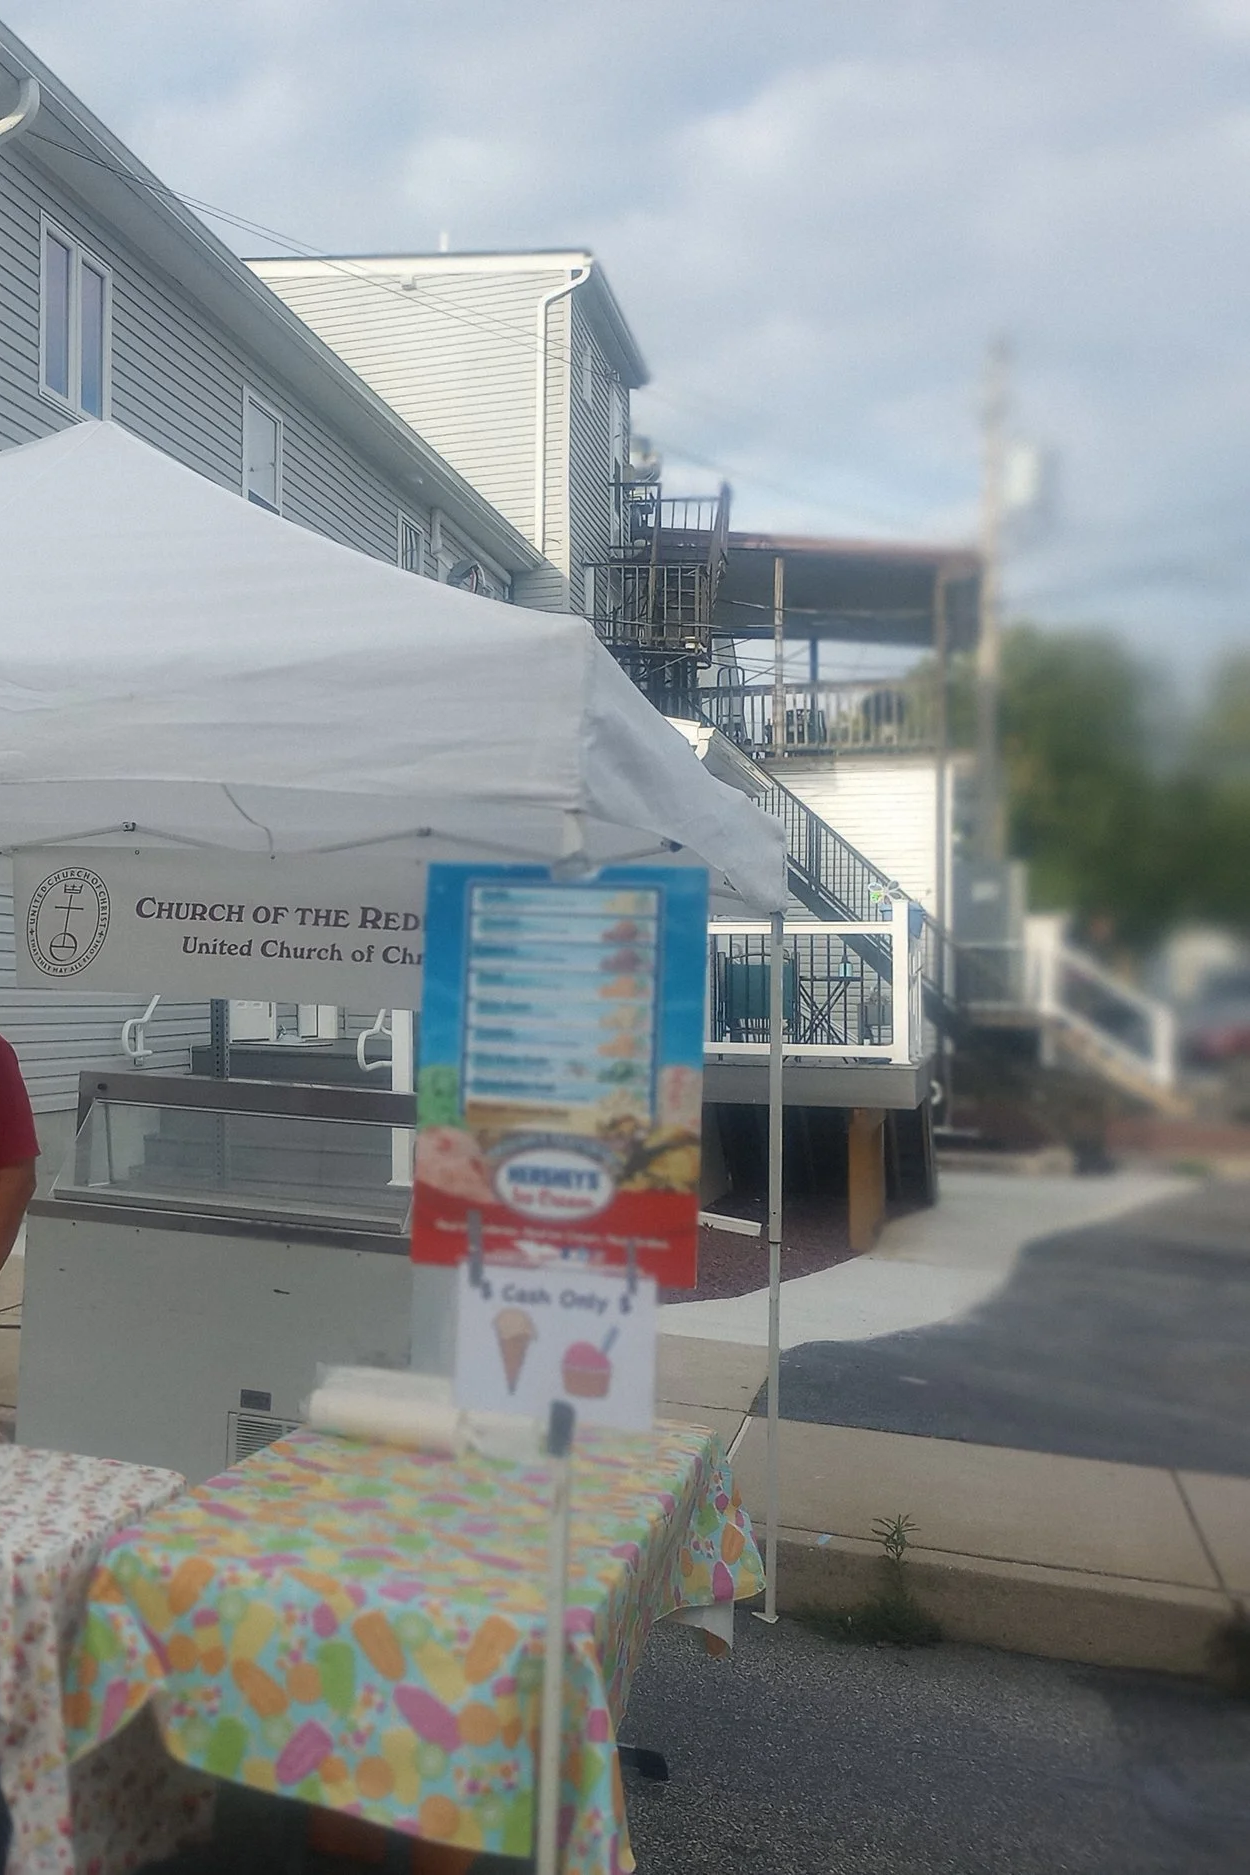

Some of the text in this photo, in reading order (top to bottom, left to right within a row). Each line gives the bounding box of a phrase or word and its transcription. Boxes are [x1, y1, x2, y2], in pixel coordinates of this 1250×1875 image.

[29, 886, 47, 925] UNITED
[47, 870, 91, 886] CHURCH
[135, 897, 245, 923] CHURCH
[252, 905, 288, 925] OF
[294, 907, 350, 929] THE
[182, 935, 252, 957] United
[260, 939, 343, 961] Church
[350, 945, 375, 963] of
[500, 1283, 552, 1306] Cash
[558, 1287, 609, 1316] Only
